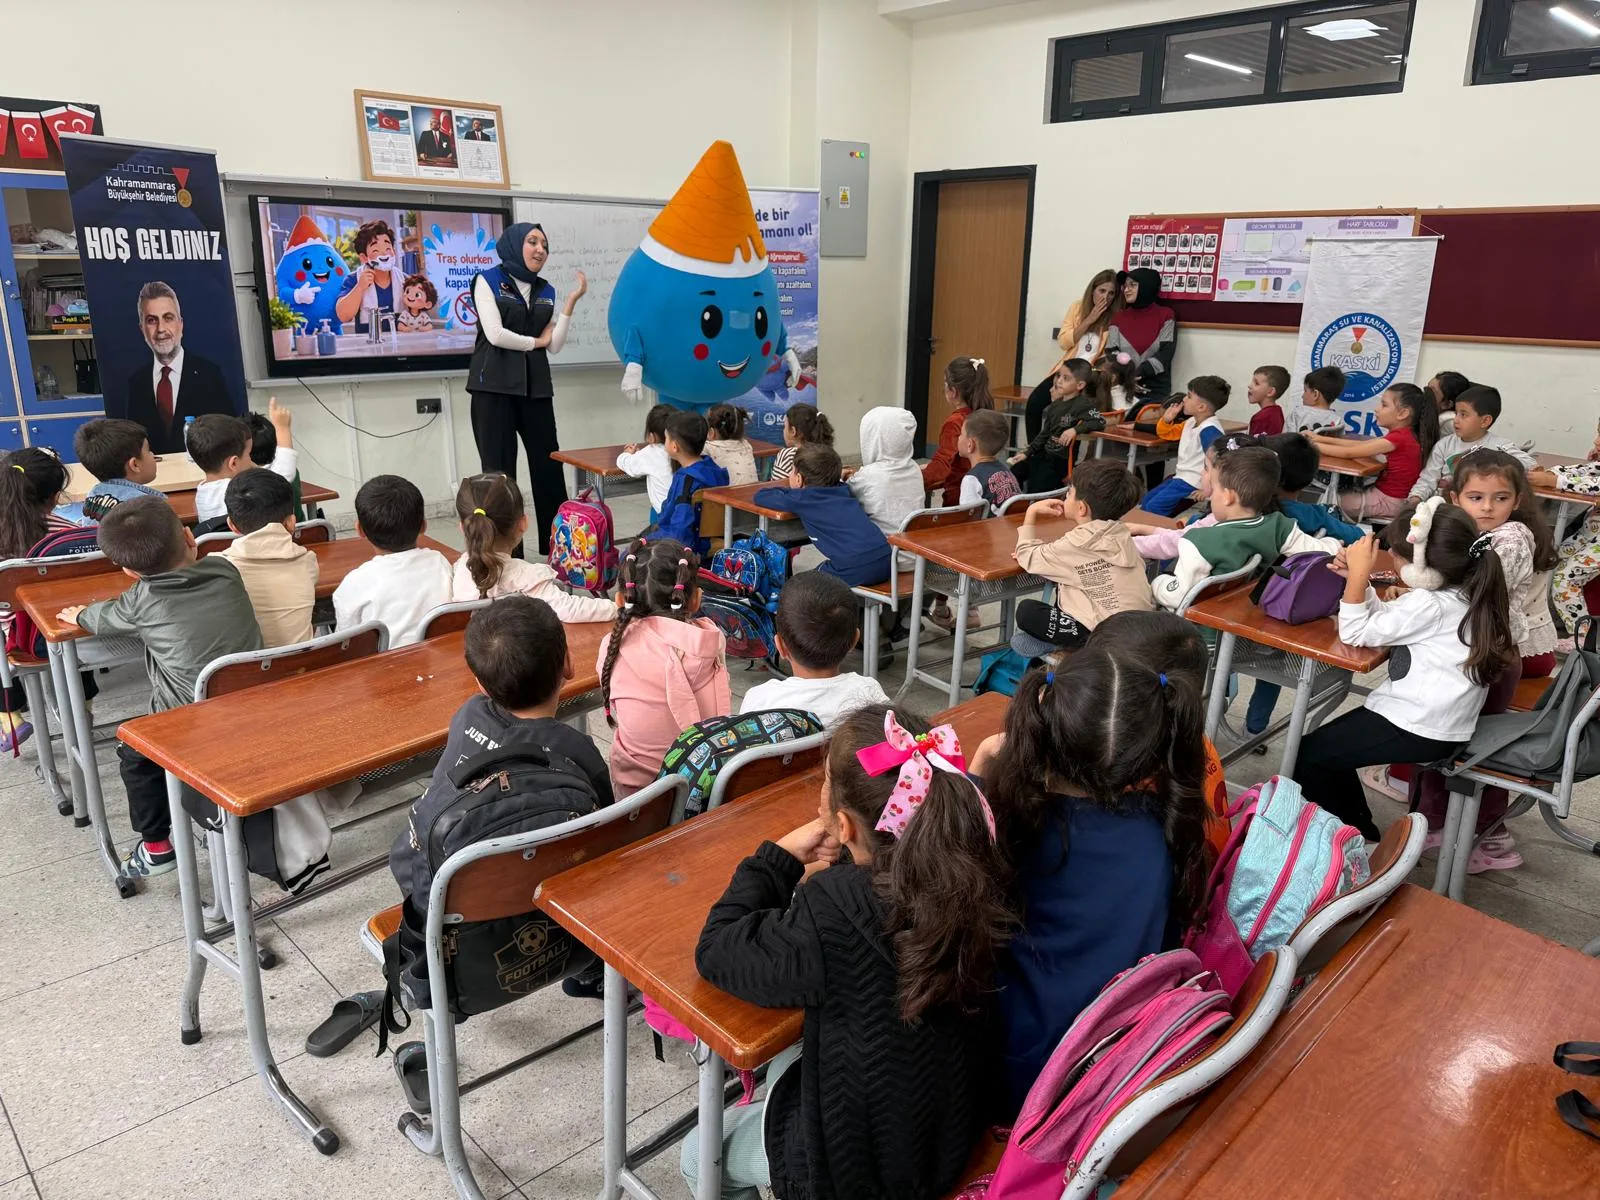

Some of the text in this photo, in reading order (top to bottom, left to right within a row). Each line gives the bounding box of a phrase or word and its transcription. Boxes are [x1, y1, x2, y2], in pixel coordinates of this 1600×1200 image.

[106, 176, 176, 192] Kahramanmaraş
[107, 189, 177, 204] Büyükşehir Belediyesi
[772, 207, 790, 221] bir
[798, 223, 812, 236] ol!
[84, 226, 222, 263] HOŞ GELDİNİZ
[436, 253, 493, 266] Traş olurken
[1339, 318, 1350, 327] SU
[1352, 315, 1362, 323] VE
[1364, 316, 1399, 365] KANALİZASYON
[1330, 353, 1381, 370] KASKİ
[464, 726, 489, 745] JUST
[504, 940, 569, 984] FOOTBALL
